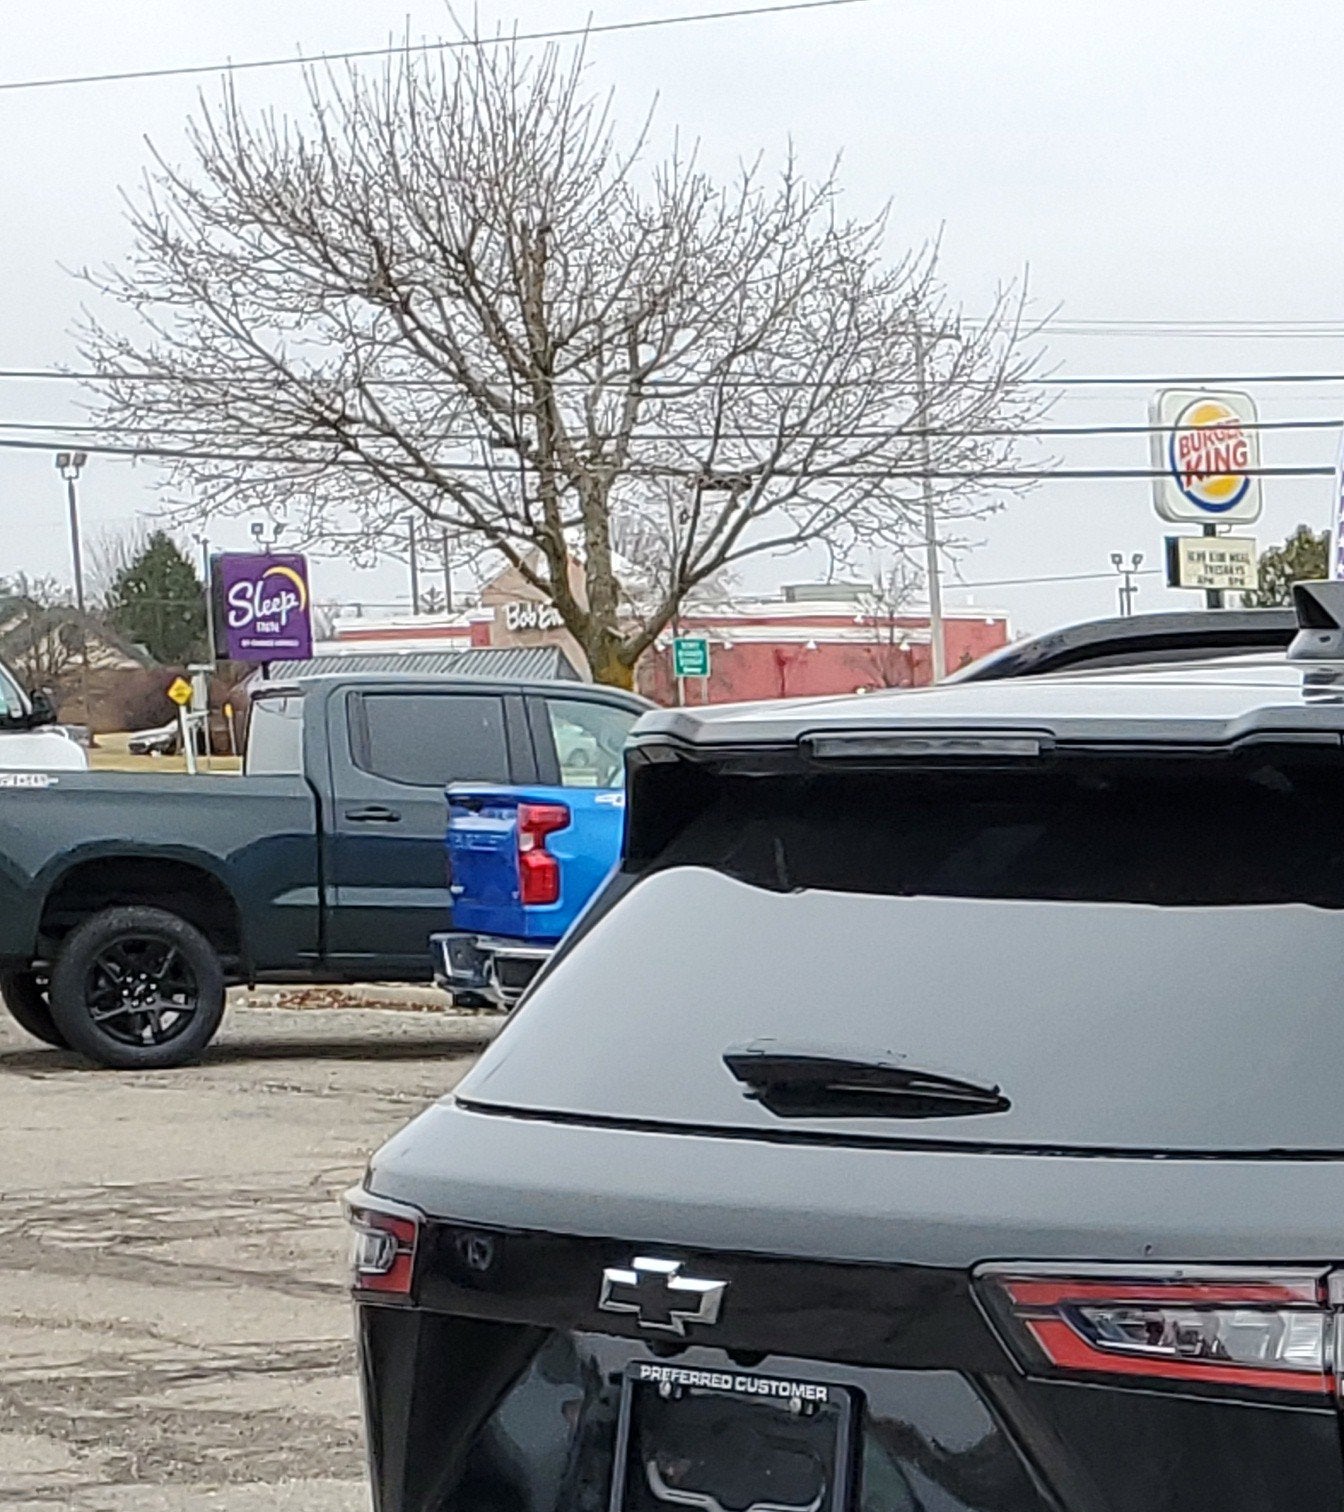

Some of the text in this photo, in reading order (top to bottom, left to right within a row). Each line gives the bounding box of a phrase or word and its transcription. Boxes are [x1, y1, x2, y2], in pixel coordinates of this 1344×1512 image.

[1184, 440, 1248, 487] KING
[228, 580, 300, 628] Sleep
[502, 602, 537, 630] Bob
[640, 1364, 828, 1402] PREFERRED CUSTOMER
